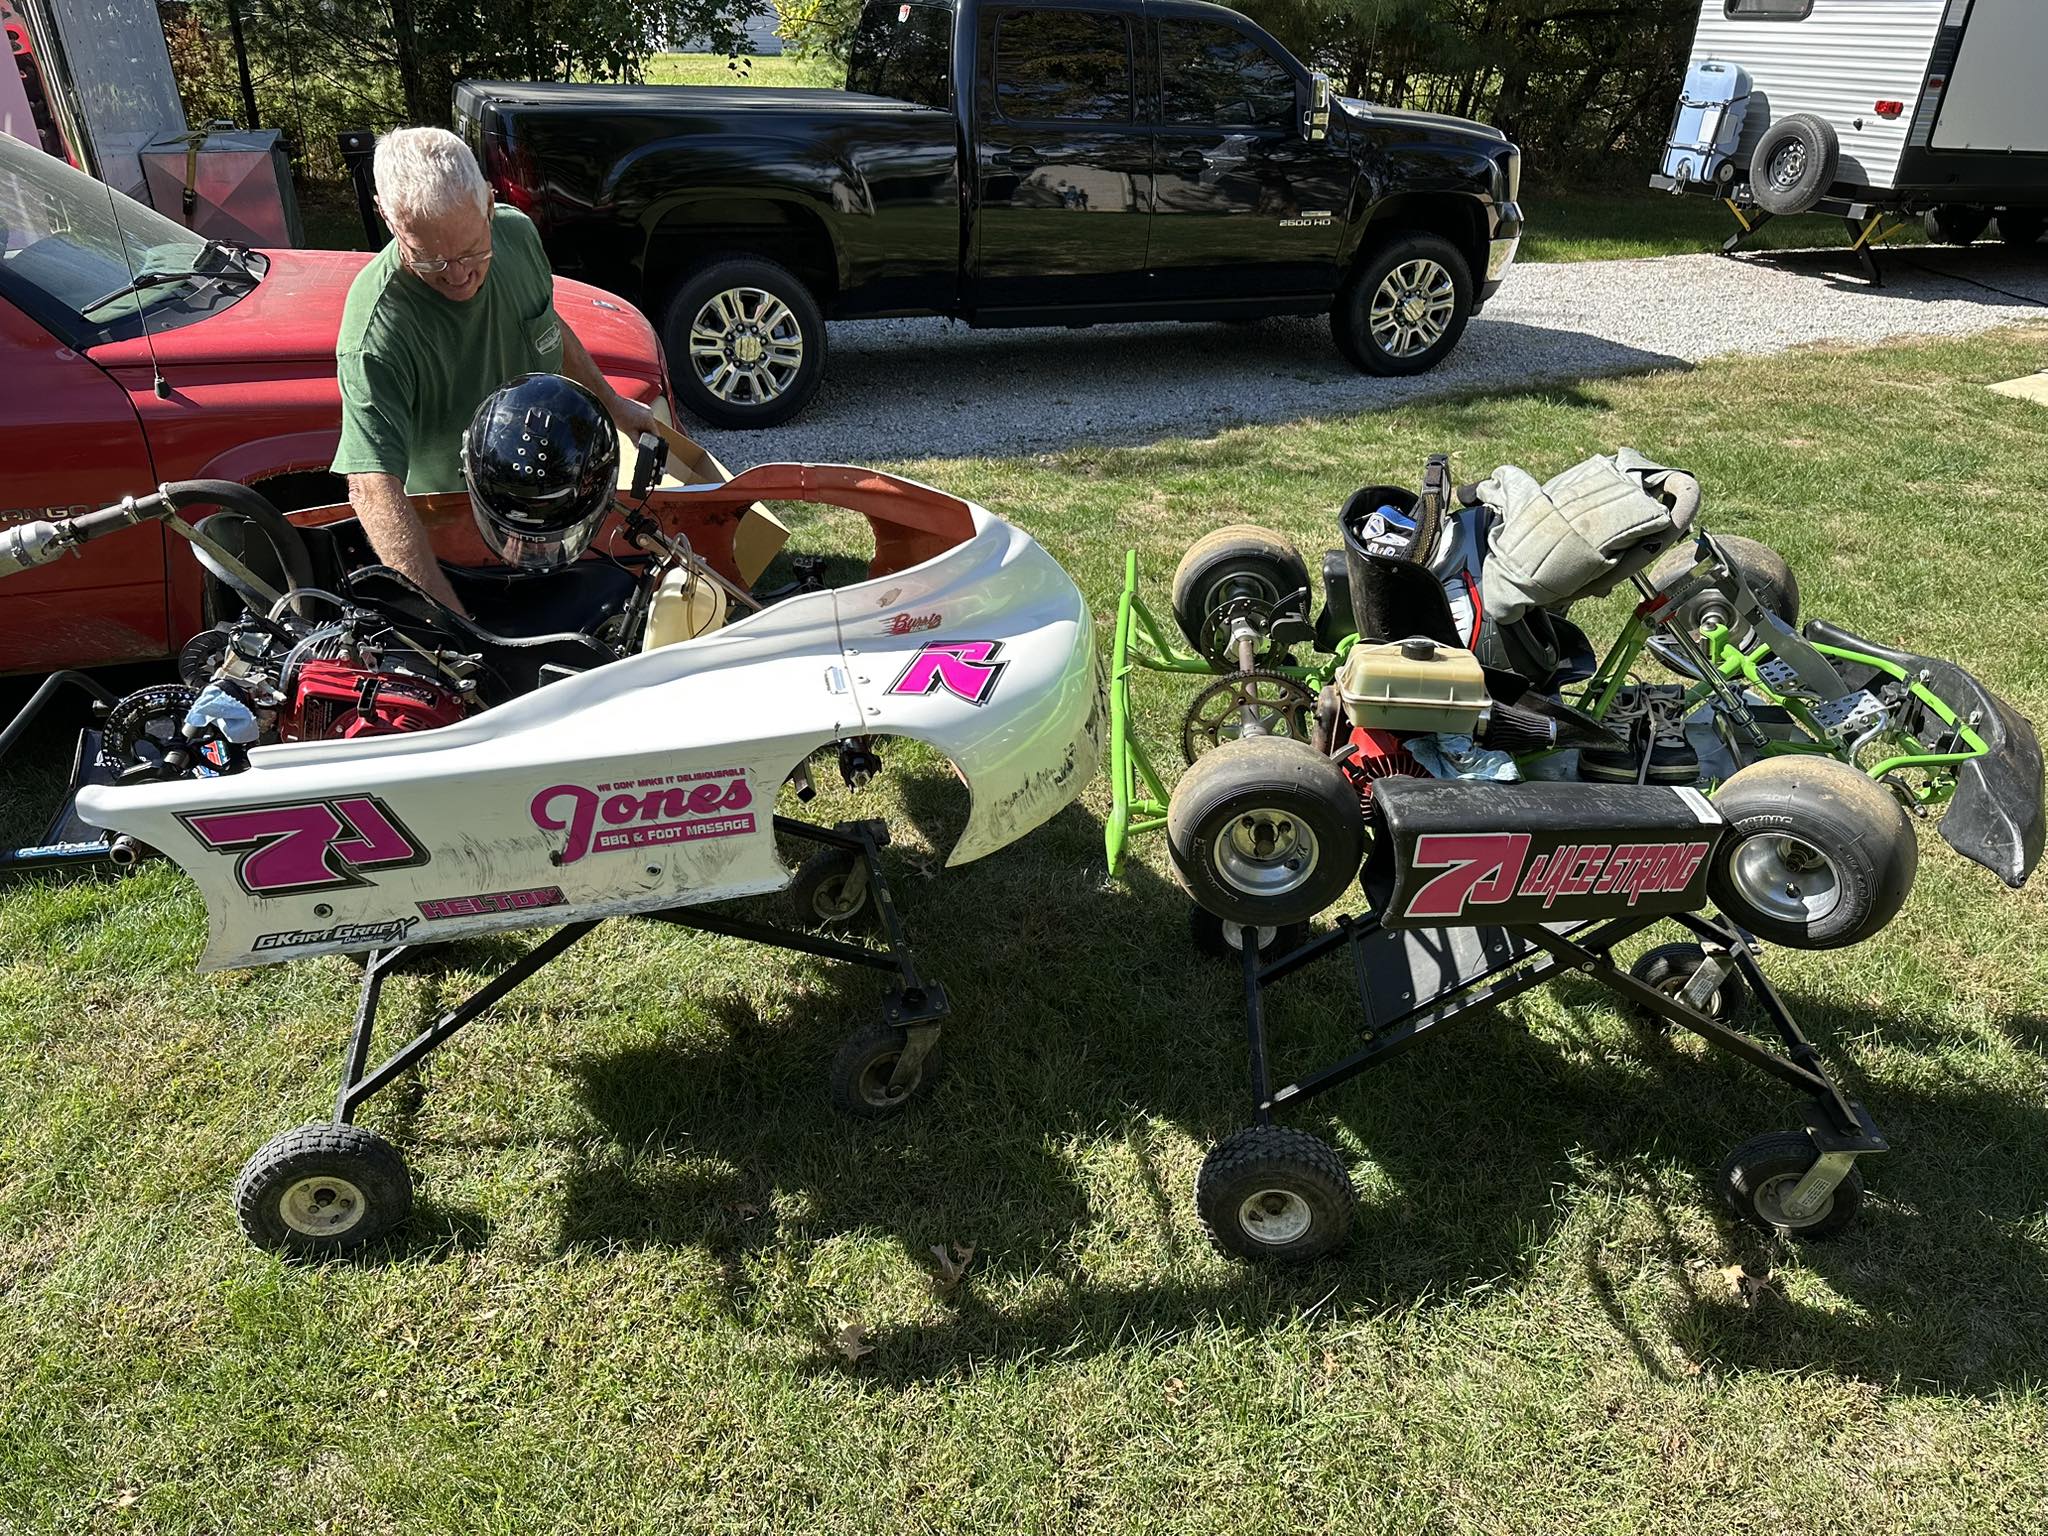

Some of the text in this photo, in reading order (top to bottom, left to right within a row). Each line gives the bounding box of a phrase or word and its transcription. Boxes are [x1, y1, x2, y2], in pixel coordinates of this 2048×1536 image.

[1280, 218, 1331, 227] 2500 HD
[597, 783, 611, 793] WE
[637, 776, 664, 789] MAKE
[666, 775, 675, 785] IT
[530, 778, 753, 864] Jones
[600, 817, 750, 848] BBQ & FOOT MASSAGE
[174, 793, 428, 897] 7J
[1404, 833, 1531, 917] 7J
[421, 889, 556, 920] HELTON
